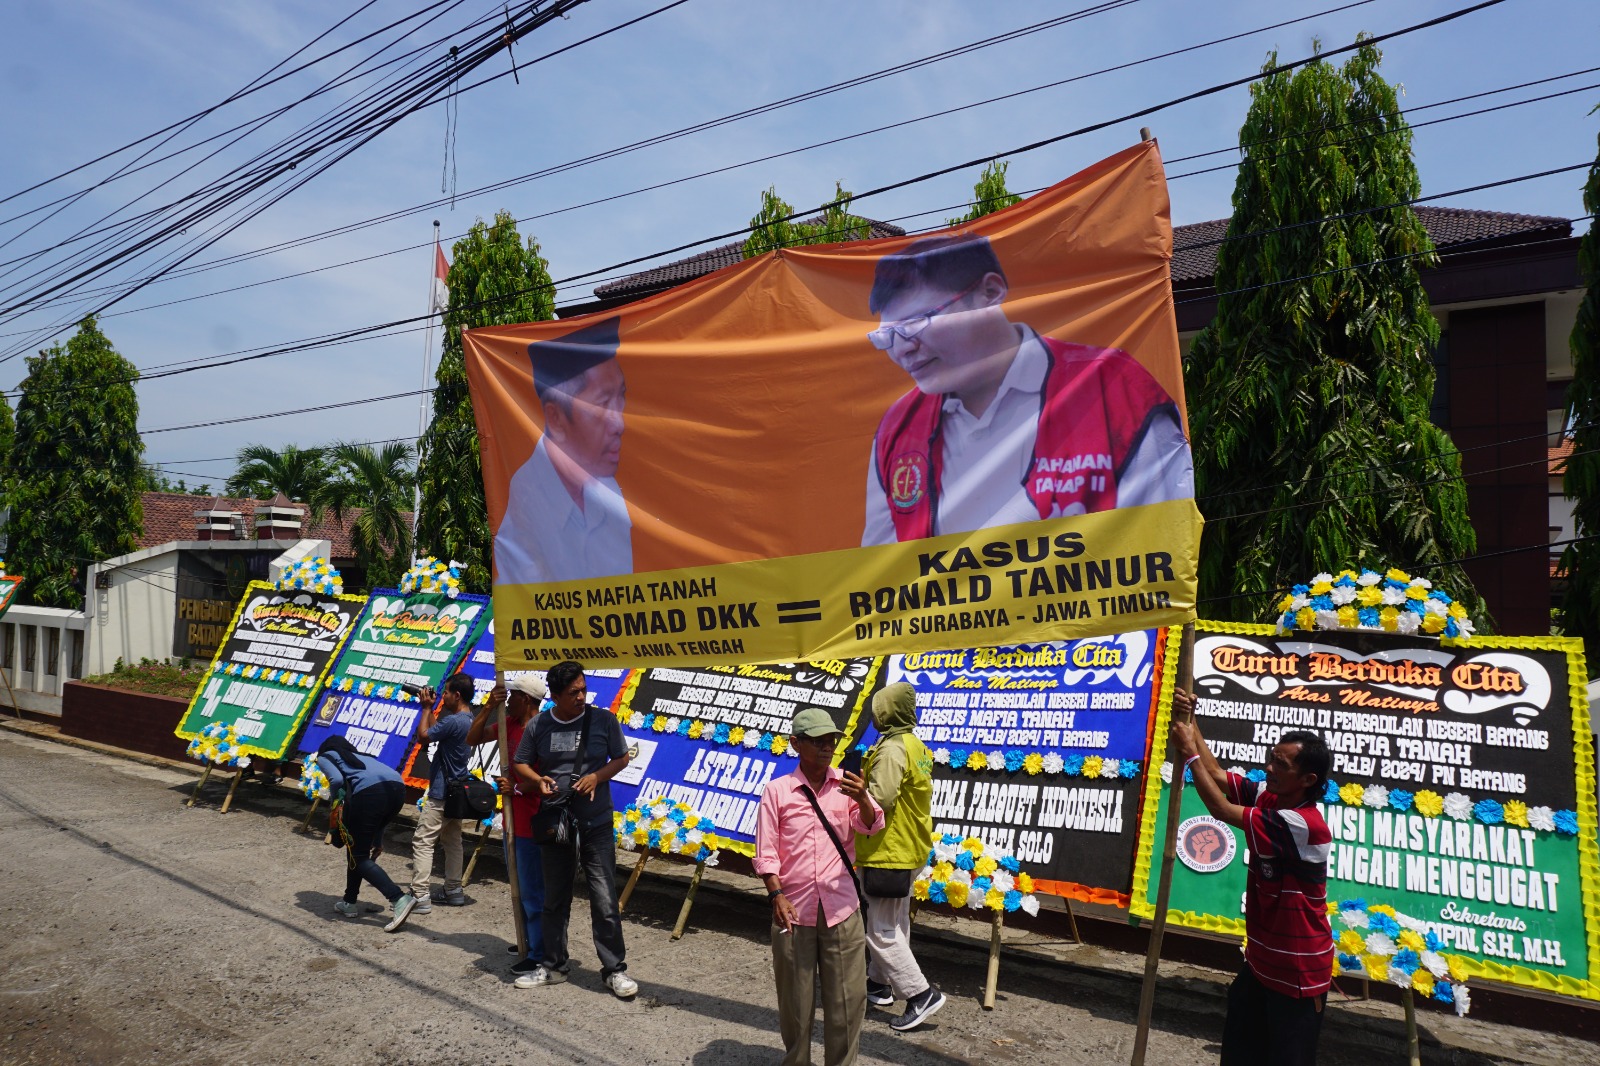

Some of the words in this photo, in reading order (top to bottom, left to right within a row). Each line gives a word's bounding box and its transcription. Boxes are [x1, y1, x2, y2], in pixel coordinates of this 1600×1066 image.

[918, 532, 1086, 577] KASUS
[534, 590, 583, 610] KASUS
[586, 584, 645, 607] MAFIA
[647, 576, 717, 601] TANAH
[849, 574, 992, 618] RONALD
[1006, 551, 1176, 599] TANNUR
[511, 617, 582, 641] ABDUL
[588, 607, 687, 639] SOMAD
[696, 602, 761, 631] DKK
[855, 622, 872, 641] DI
[879, 619, 902, 638] PN
[909, 608, 1010, 635] SURABAYA
[1032, 600, 1091, 625] JAWA
[1097, 590, 1172, 616] TIMUR
[188, 623, 228, 647] BATAN
[524, 648, 538, 661] DI
[541, 648, 560, 660] PN
[565, 645, 619, 661] BATANG
[633, 641, 674, 658] JAWA
[677, 638, 745, 656] TENGAH
[737, 664, 793, 683] Matinya
[904, 651, 967, 671] Turut
[971, 645, 1068, 672] Berduka
[1072, 644, 1123, 667] Cita
[1213, 647, 1300, 676] Turut
[1309, 653, 1443, 686] Berduka
[1452, 664, 1523, 692] Cita
[945, 675, 983, 689] Atas
[987, 675, 1059, 691] Matinya
[1278, 685, 1331, 703] Atas
[1339, 689, 1440, 714] Matinya
[677, 685, 717, 704] KASUS
[713, 690, 754, 710] MAFIA
[753, 697, 798, 718] TANAH
[932, 692, 970, 708] HUKUM
[969, 693, 982, 708] DI
[980, 693, 1047, 709] PENGADILAN
[1047, 693, 1089, 709] NEGERI
[1090, 693, 1136, 710] BATANG
[919, 709, 968, 726] KASUS
[969, 710, 1019, 728] MAFIA
[1022, 711, 1075, 728] TANAH
[1195, 697, 1263, 722] ENEGAKAN
[1265, 704, 1315, 727] HUKUM
[1317, 709, 1332, 729] DI
[1333, 711, 1424, 738] PENGADILAN
[1426, 719, 1482, 743] NEGERI
[1486, 726, 1549, 750] BATANG
[1042, 730, 1060, 746] PN
[1062, 730, 1110, 748] BATANG
[1324, 731, 1391, 757] MAFIA
[1396, 737, 1472, 766] TANAH
[684, 748, 777, 796] ASTRADA
[1381, 759, 1426, 783] 2024/
[1432, 764, 1455, 786] PN
[1459, 768, 1527, 793] BATANG
[931, 779, 968, 819] RIMA
[967, 781, 1038, 826] PARQUET
[1038, 786, 1124, 833] INDONESIA
[1017, 830, 1054, 864] SOLO
[1373, 810, 1537, 867] MASYARAKAT
[1327, 843, 1399, 888] ENGAH
[1406, 854, 1559, 912] MENGGUGAT
[1440, 902, 1527, 932] Sekretaris
[1523, 936, 1566, 967] M.H.
